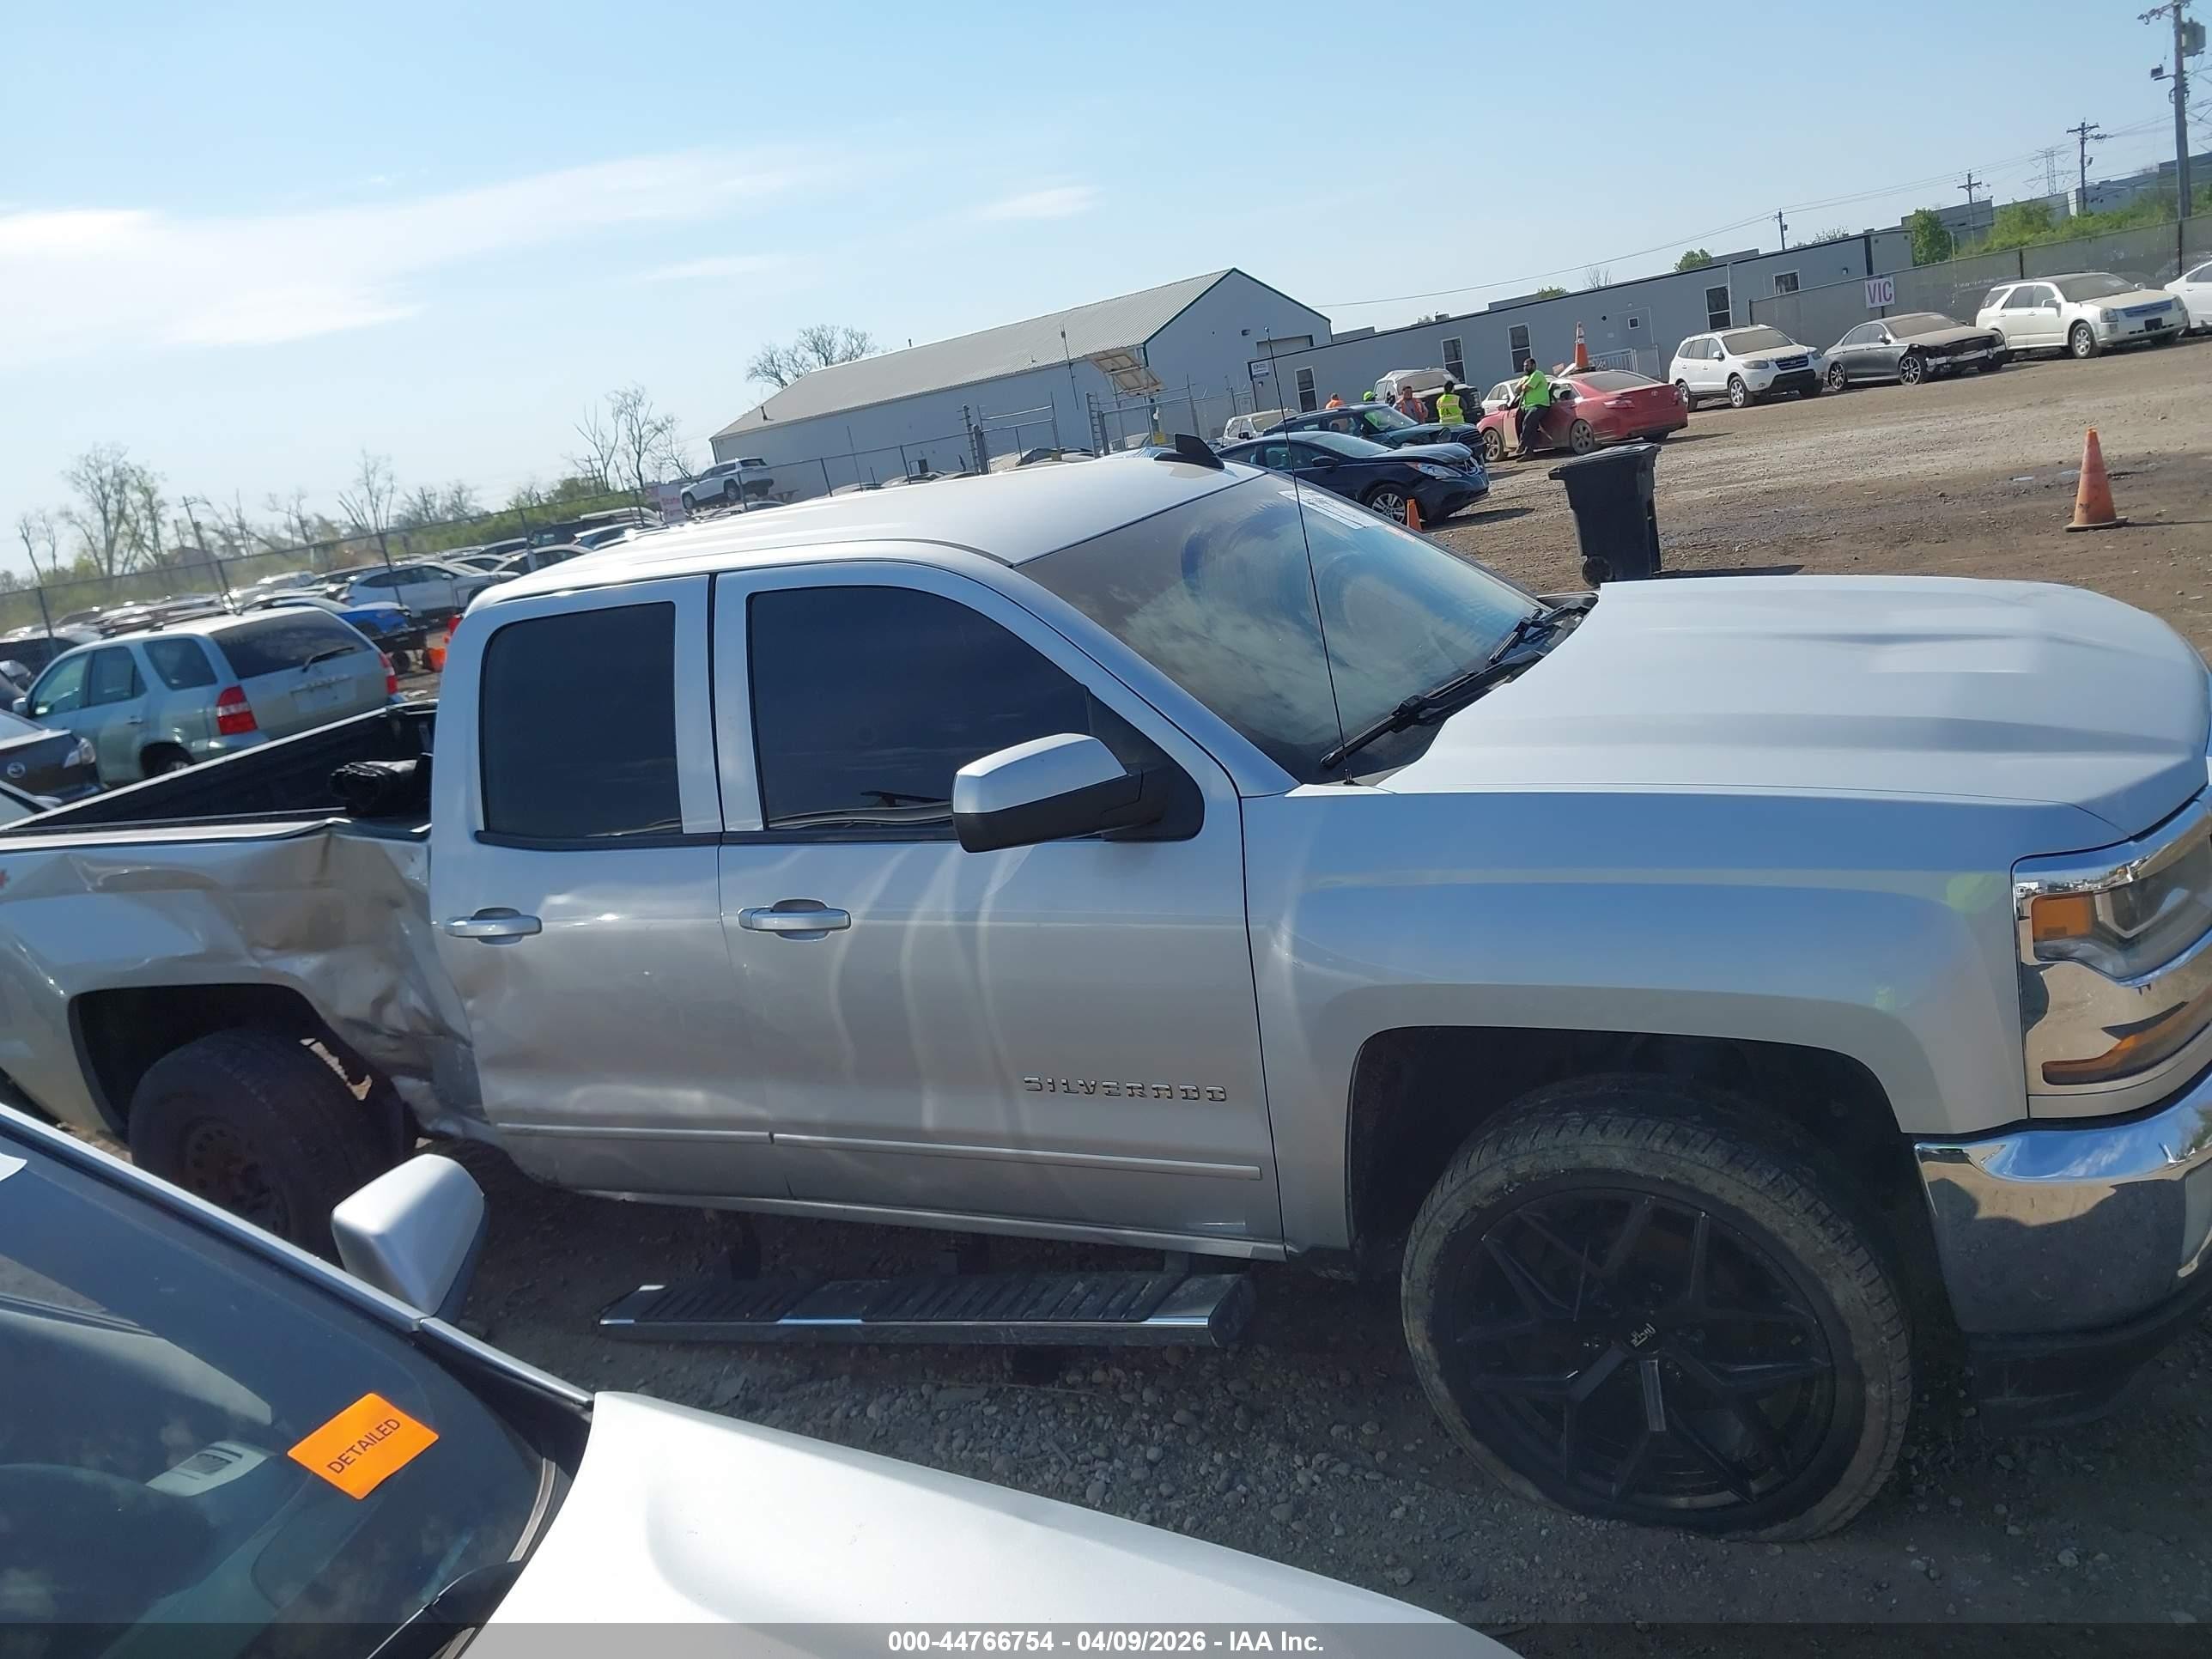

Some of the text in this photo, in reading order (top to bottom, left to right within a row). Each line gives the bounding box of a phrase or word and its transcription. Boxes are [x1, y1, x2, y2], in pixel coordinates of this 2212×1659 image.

[1867, 280, 1893, 304] VIC
[1024, 1077, 1227, 1102] SILVERADO
[326, 1419, 401, 1474] DETAILED
